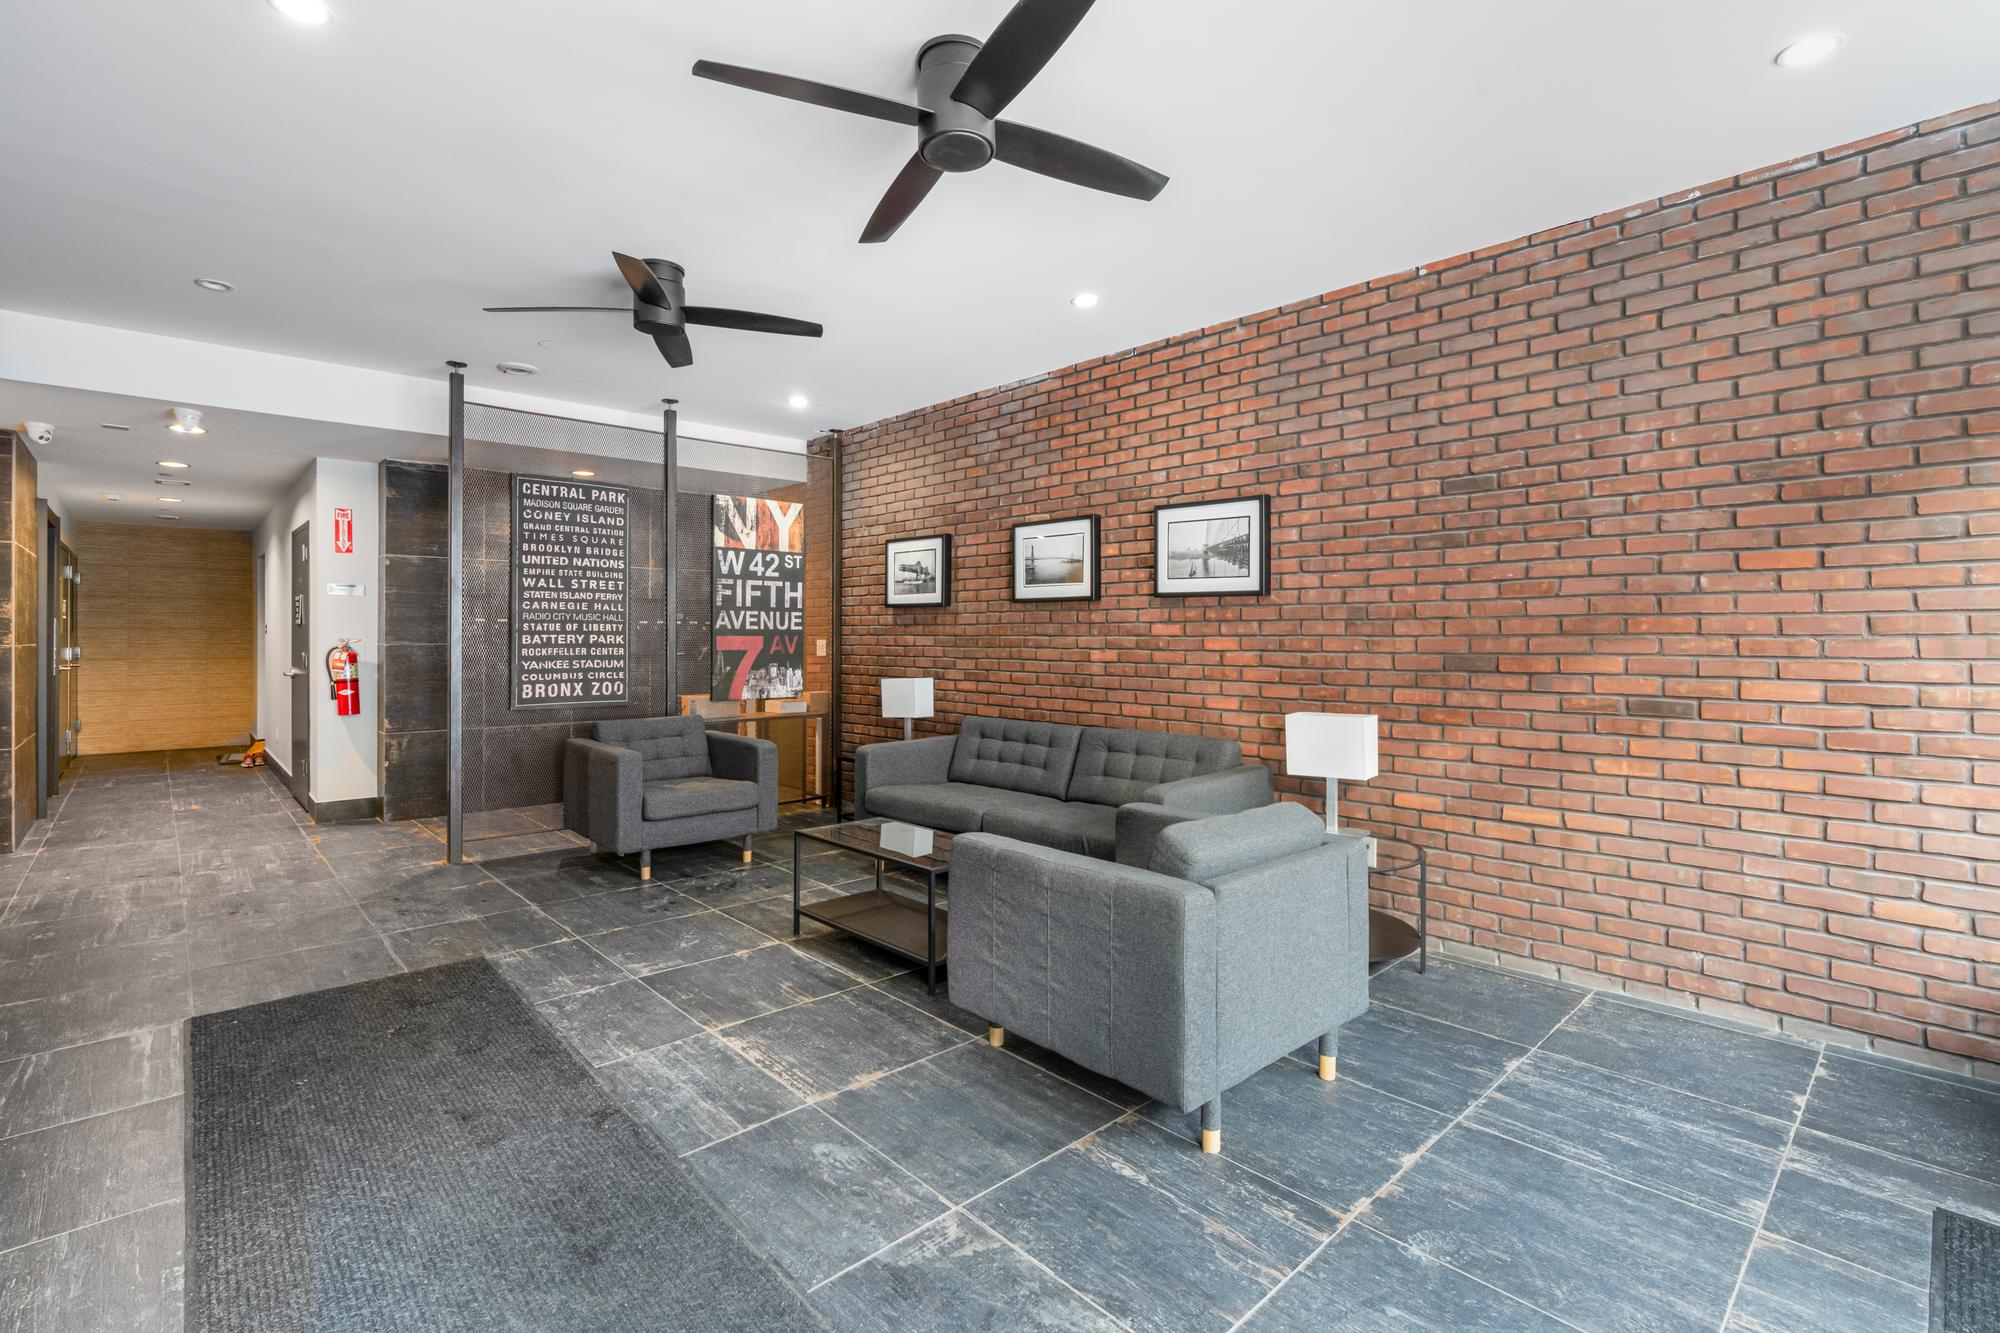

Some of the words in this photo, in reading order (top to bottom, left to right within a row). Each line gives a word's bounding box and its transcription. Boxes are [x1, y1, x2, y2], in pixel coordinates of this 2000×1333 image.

[523, 483, 586, 499] CENTRAL
[592, 490, 625, 503] PARK
[524, 499, 560, 509] MADISON
[563, 502, 592, 511] SQUARE
[595, 505, 624, 514] GARDEN
[523, 510, 571, 521] CONEY
[577, 514, 624, 525] ISLAND
[714, 495, 803, 552] NY
[524, 523, 551, 531] GRAND
[555, 525, 589, 534] CENTRAL
[593, 528, 624, 536] STATION
[524, 532, 563, 542] TIMES
[573, 536, 623, 545] SQUARE
[523, 543, 580, 553] BROOKLYN
[587, 547, 624, 557] BRIDGE
[522, 555, 568, 565] UNITED
[573, 558, 624, 568] NATIONS
[718, 550, 745, 575] W
[749, 553, 779, 577] 42
[785, 555, 802, 568] ST
[587, 571, 623, 579] BUILDING
[522, 578, 564, 587] WALL
[571, 580, 624, 590] STREET
[523, 591, 557, 599] STATEN
[716, 578, 802, 608] FIFTH
[595, 603, 624, 611] HALL
[573, 613, 600, 621] MUSIC
[715, 610, 802, 630] AVENUE
[524, 623, 560, 631] STATUE
[566, 623, 578, 631] OF
[522, 635, 584, 644] BATTERY
[590, 635, 624, 644] PARK
[522, 661, 569, 669] YANKEE
[573, 660, 623, 668] STADIUM
[716, 636, 764, 700] 7
[769, 635, 798, 655] AV
[522, 672, 583, 680] COLUMBUS
[522, 682, 583, 698] BRONX
[592, 681, 623, 695] ZOO
